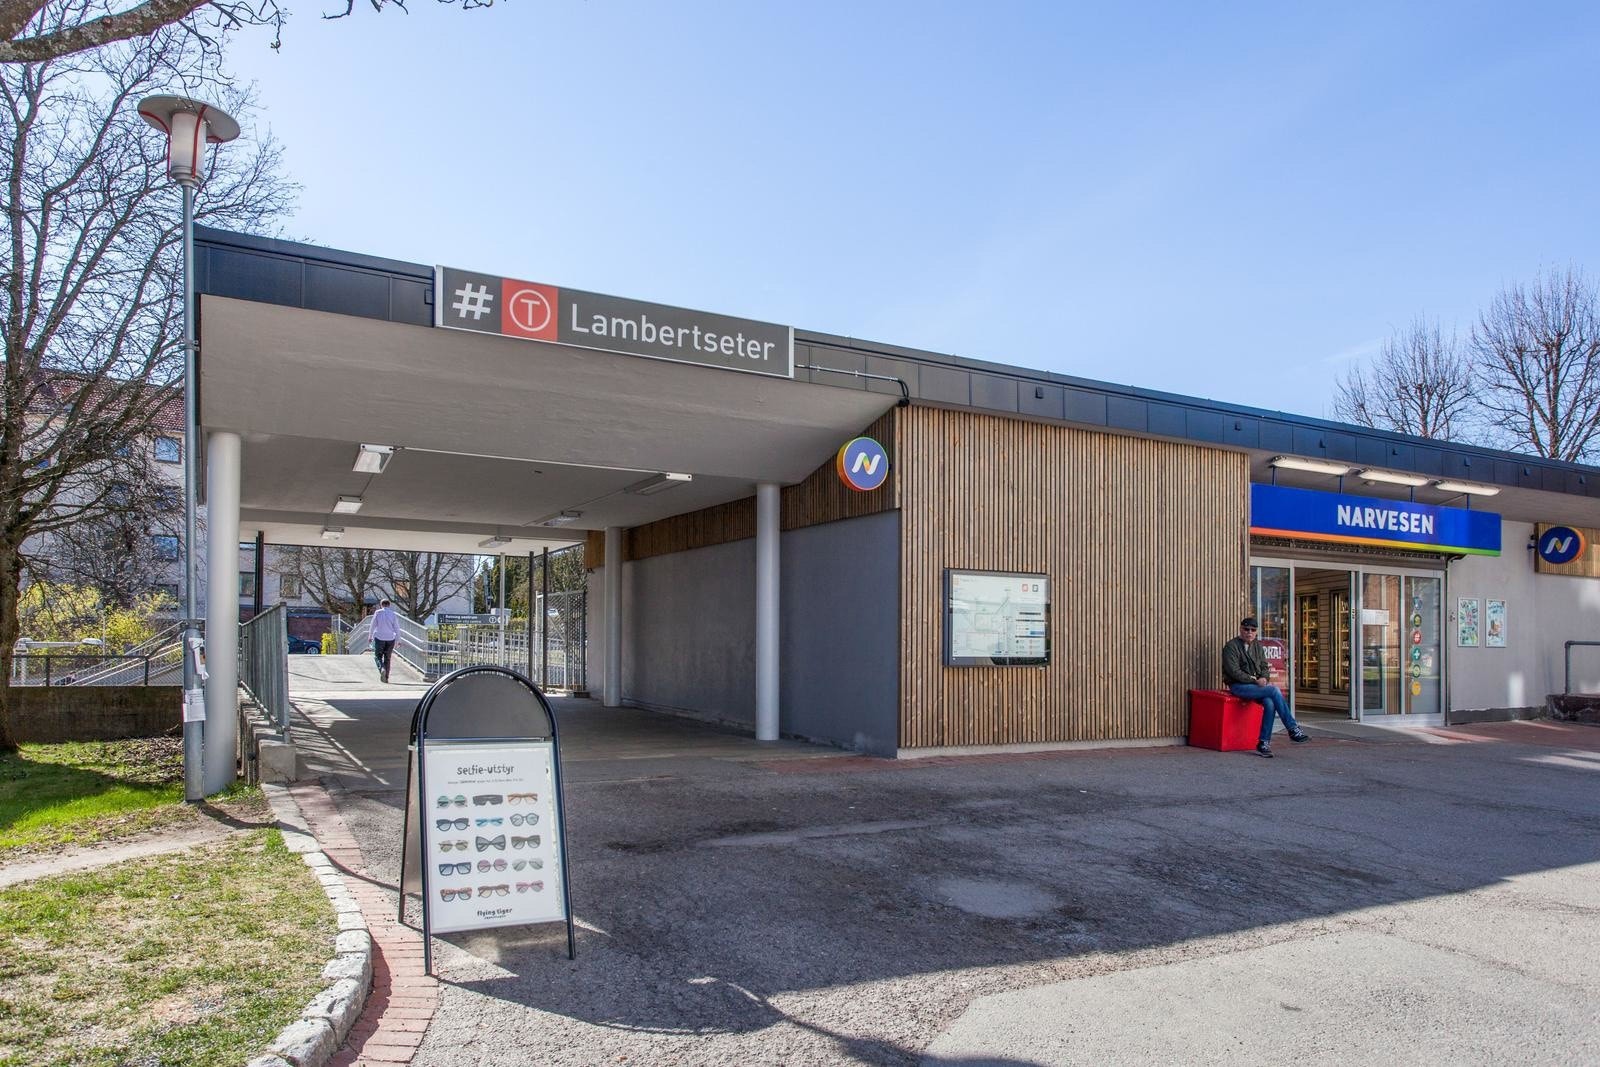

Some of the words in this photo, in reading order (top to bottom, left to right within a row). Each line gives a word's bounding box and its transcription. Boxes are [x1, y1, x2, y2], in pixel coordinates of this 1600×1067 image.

[571, 303, 775, 361] Lambertseter
[1337, 504, 1434, 535] NARVESEN
[456, 763, 515, 776] selfie-utstyr
[477, 909, 496, 917] flying
[496, 907, 513, 915] tiger
